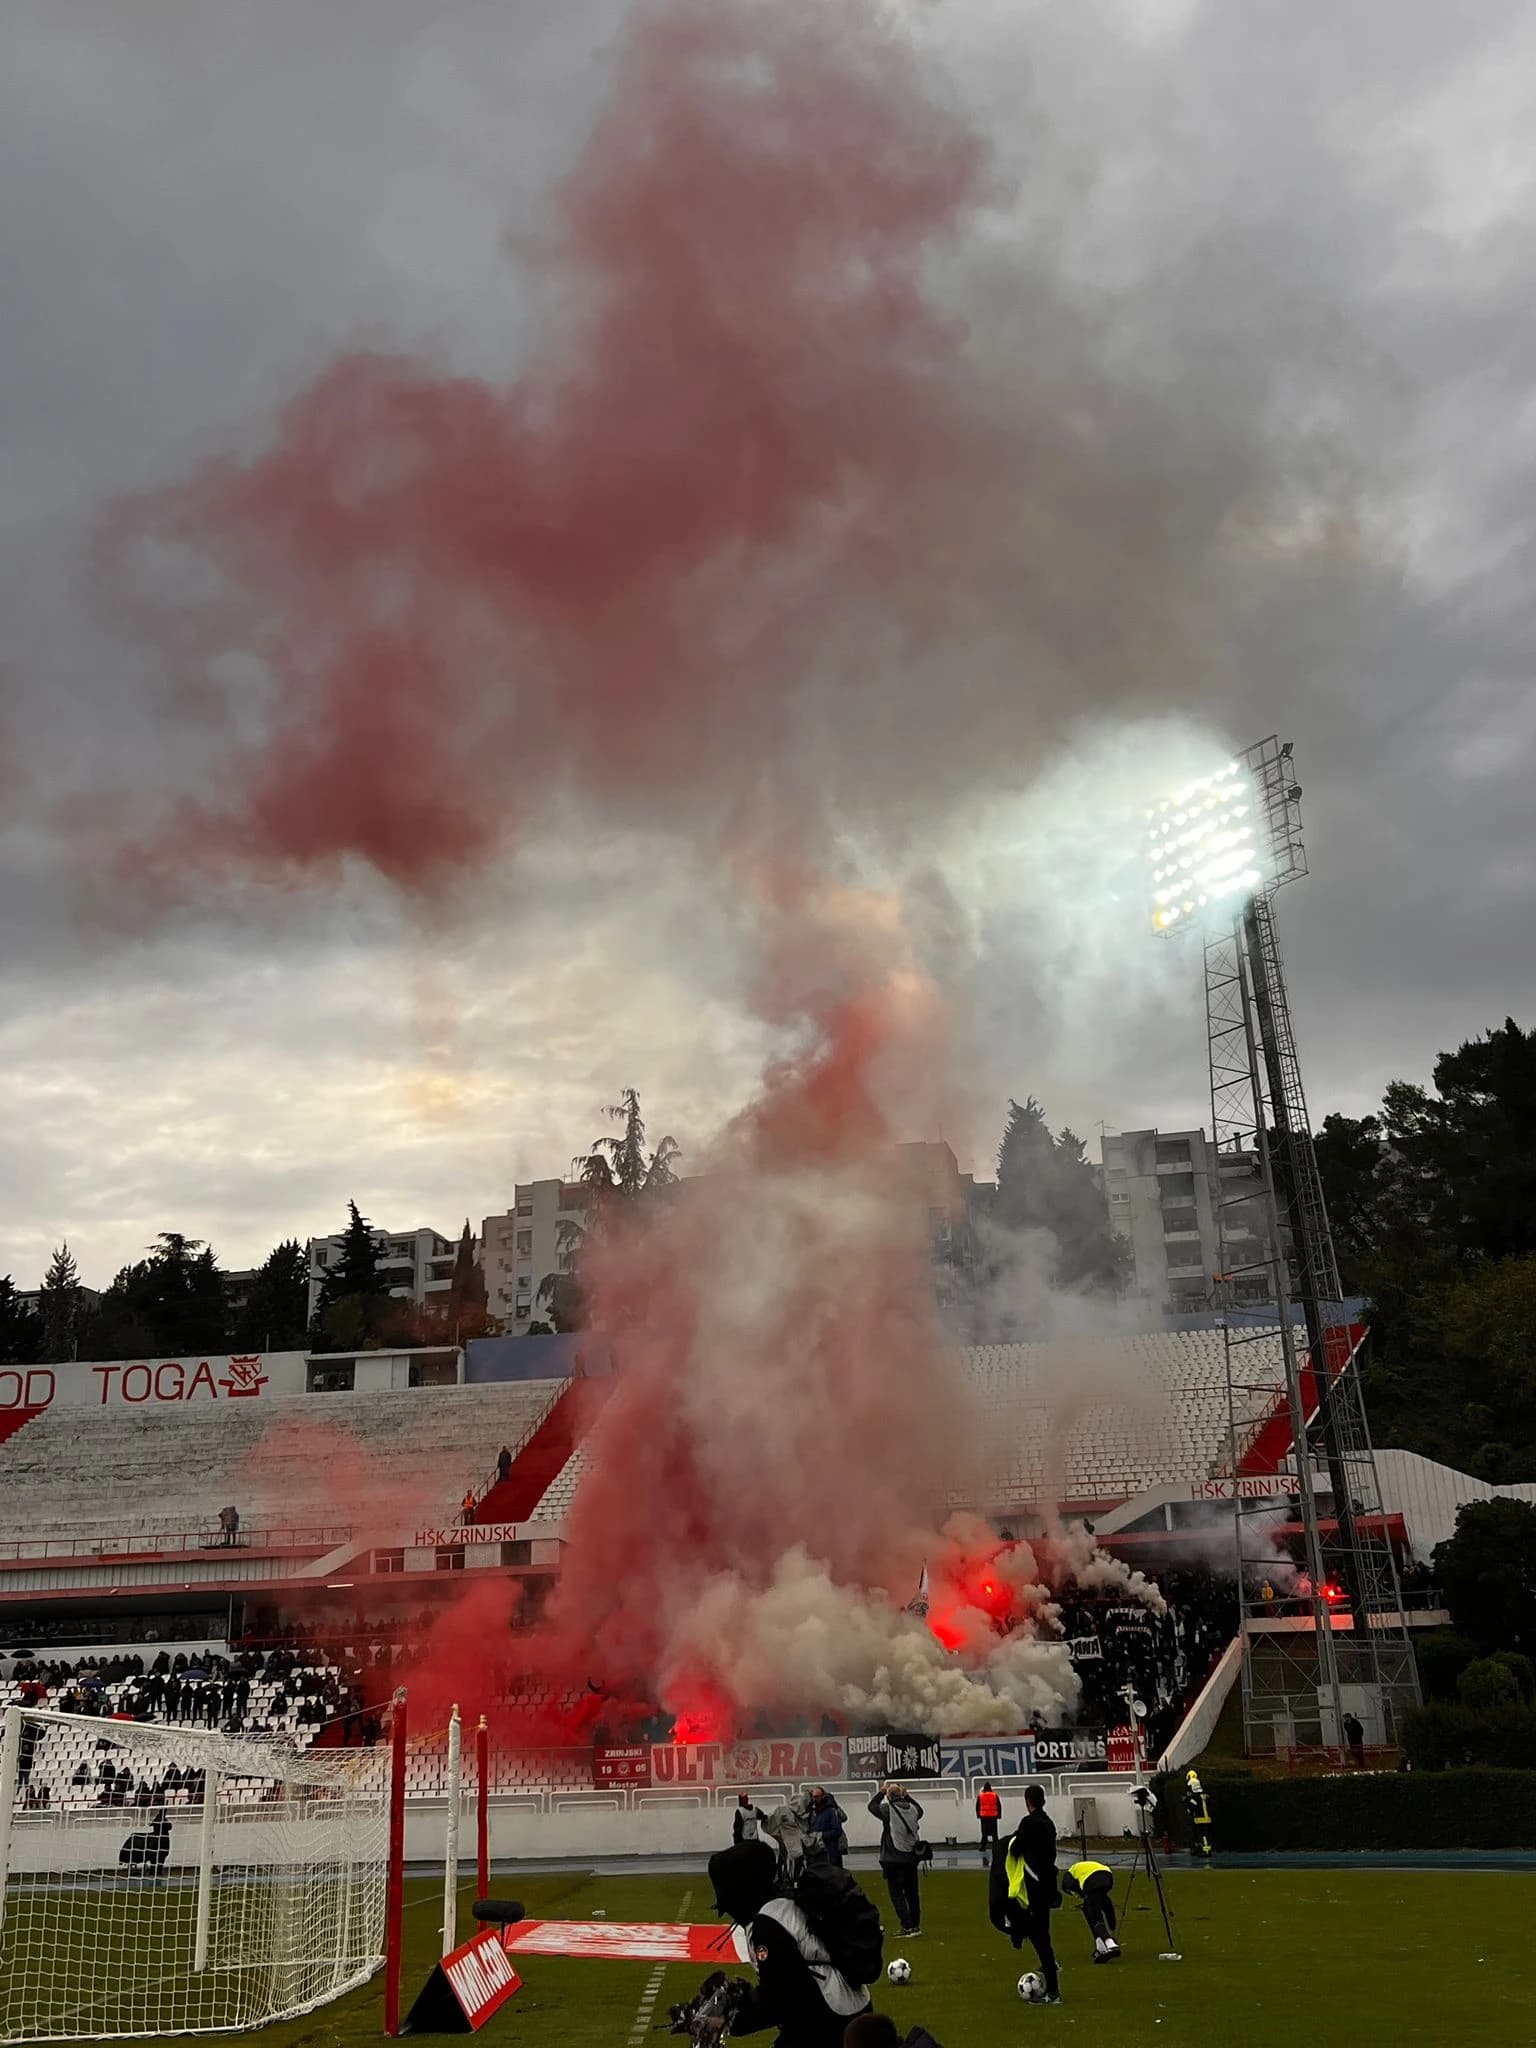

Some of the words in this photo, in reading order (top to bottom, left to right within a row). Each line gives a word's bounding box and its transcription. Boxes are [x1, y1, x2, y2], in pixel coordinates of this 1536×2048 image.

[92, 1362, 218, 1405] TOGA
[1191, 1481, 1227, 1500] HŠK
[1231, 1478, 1301, 1498] ZRINJSK
[415, 1528, 446, 1546] HŠK
[449, 1526, 517, 1544] ZRINJSKI
[848, 1735, 887, 1754] BORBA
[653, 1746, 720, 1782] ULT
[769, 1742, 843, 1777] RAS
